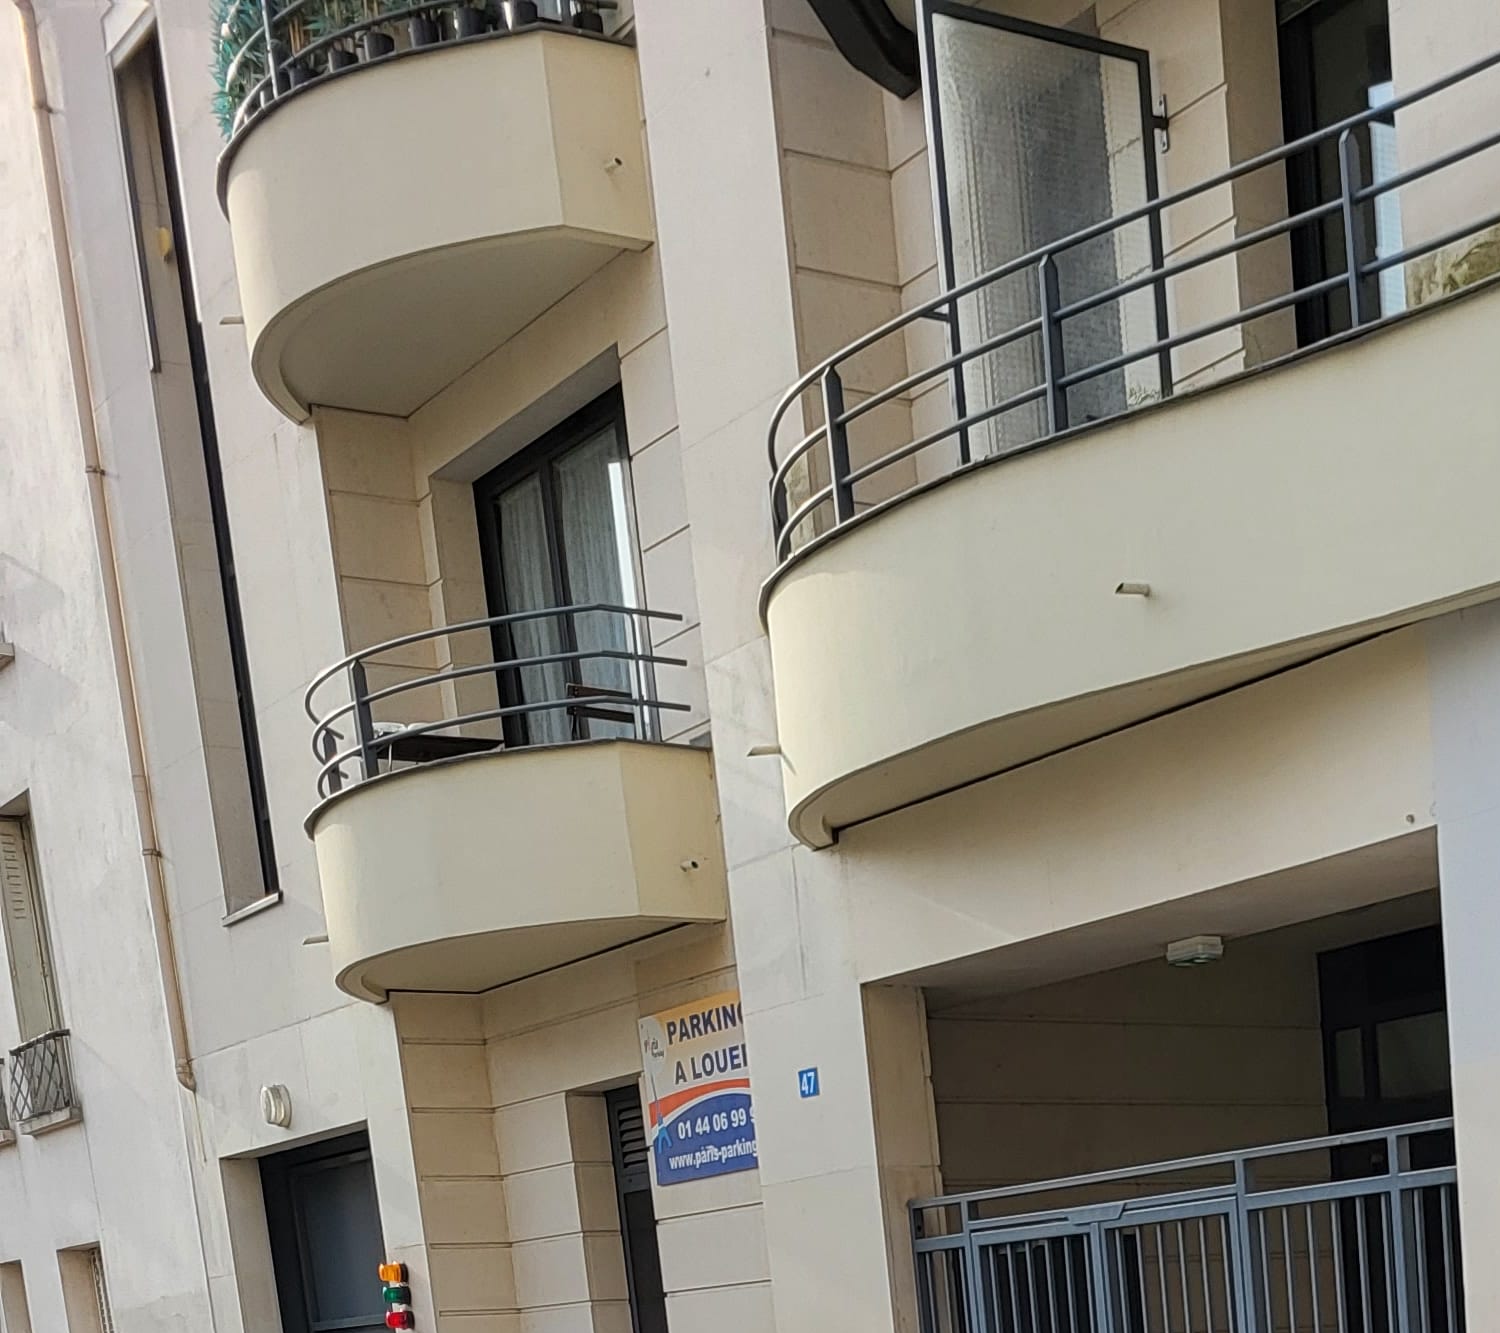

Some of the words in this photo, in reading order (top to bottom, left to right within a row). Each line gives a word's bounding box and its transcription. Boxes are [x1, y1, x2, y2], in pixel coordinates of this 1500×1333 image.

[675, 1061, 687, 1085] A
[800, 1071, 815, 1095] 47
[678, 1121, 691, 1139] 01
[695, 1117, 711, 1135] 44
[713, 1112, 728, 1131] 06
[731, 1107, 747, 1127] 99
